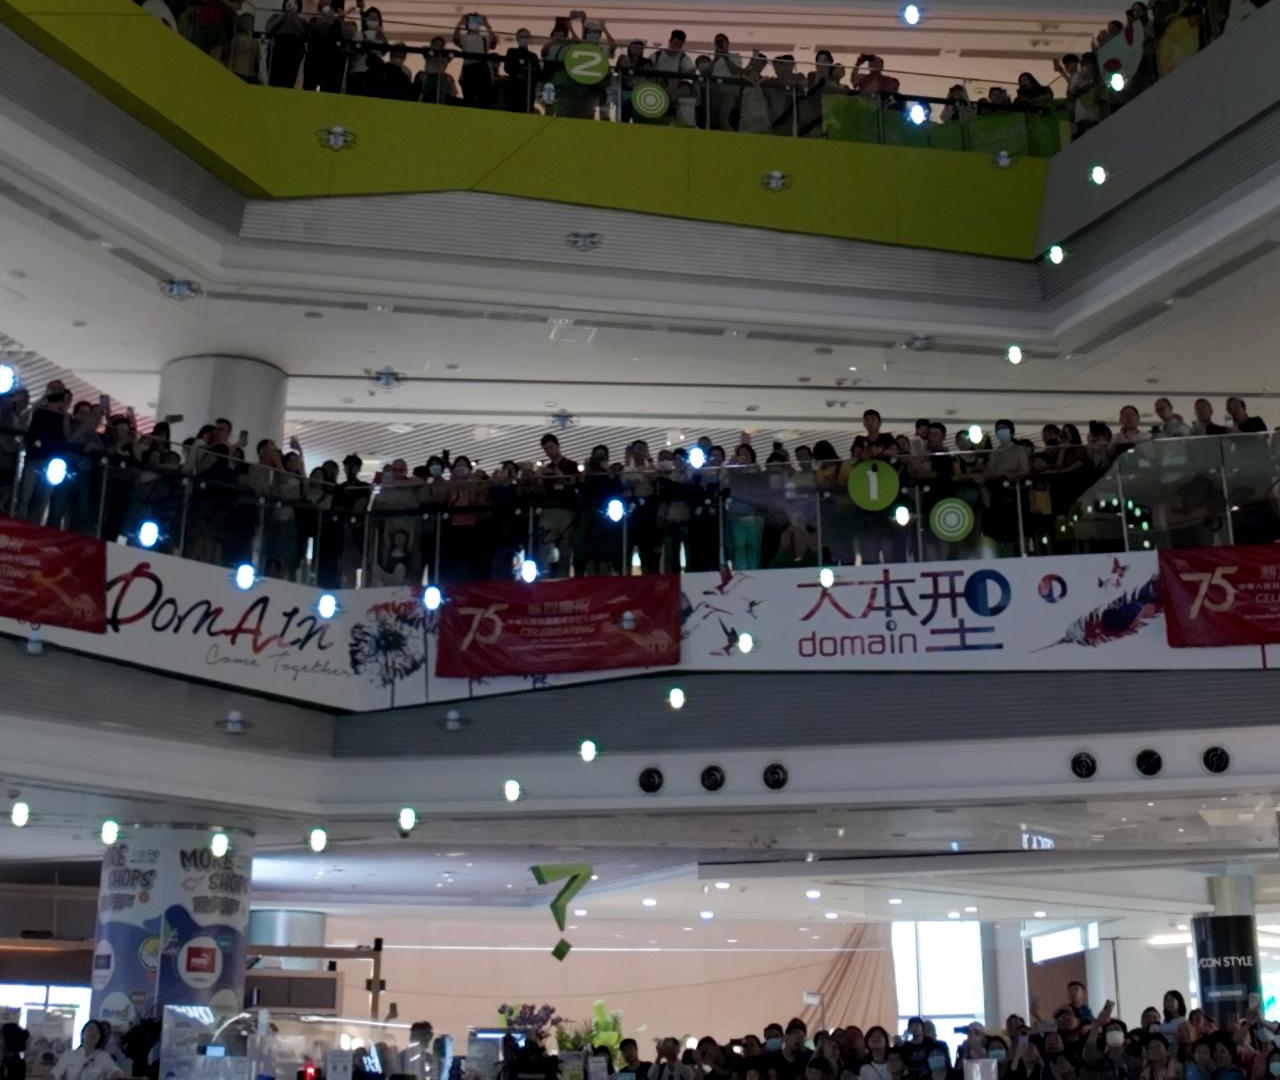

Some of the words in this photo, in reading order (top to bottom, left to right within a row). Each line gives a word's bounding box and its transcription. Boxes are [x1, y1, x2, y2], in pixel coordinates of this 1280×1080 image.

[570, 50, 602, 78] 2
[1179, 565, 1239, 620] 75
[457, 602, 509, 652] 75
[798, 619, 918, 658] domain
[1223, 956, 1253, 968] STYLE
